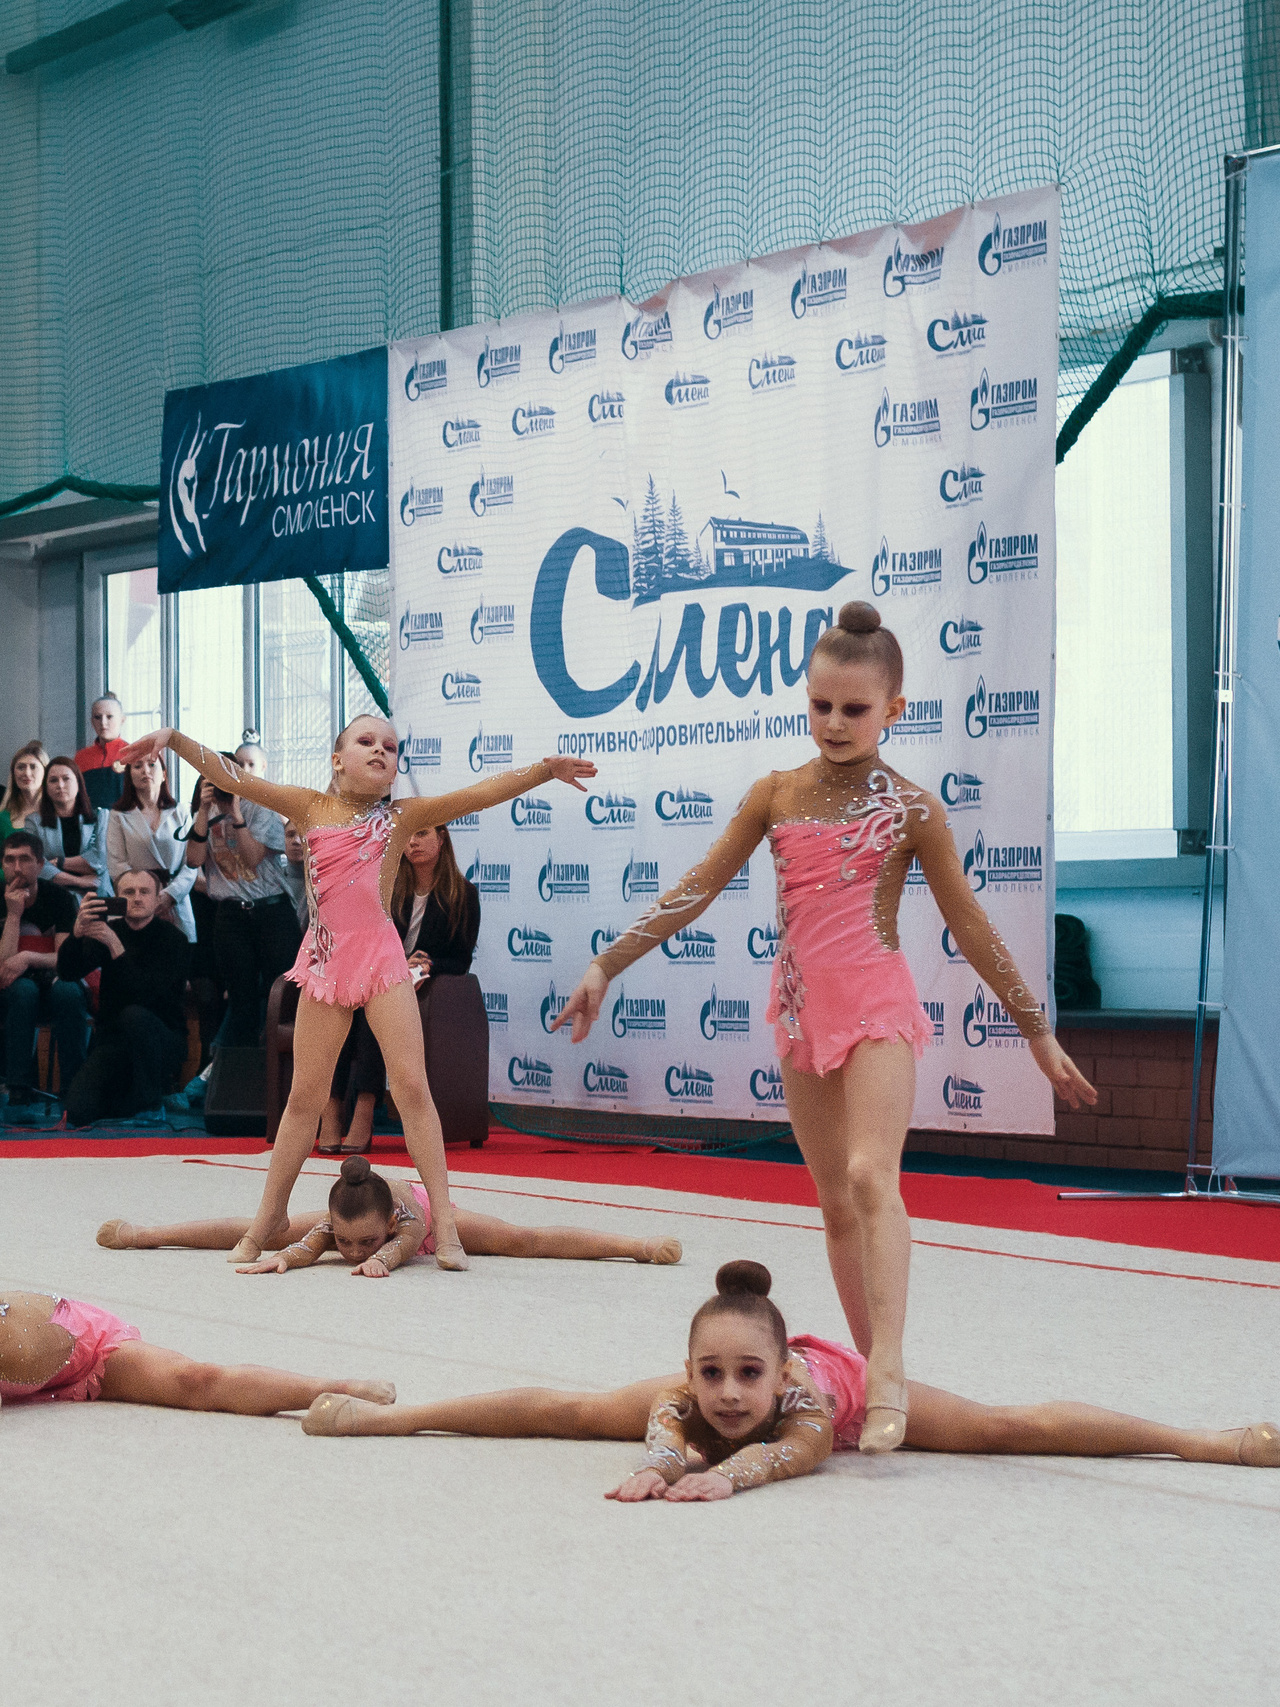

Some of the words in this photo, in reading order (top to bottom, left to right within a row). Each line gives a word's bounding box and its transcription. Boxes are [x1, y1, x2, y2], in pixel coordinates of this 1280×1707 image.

[1003, 220, 1047, 249] ГАЗПРОМ
[565, 329, 596, 351] ГАЗПРОМ
[835, 338, 886, 370] Смена
[749, 358, 795, 389] Смена
[665, 379, 709, 406] Смена
[991, 378, 1037, 405] ГАЗПРОМ
[512, 407, 555, 436] Смена
[893, 398, 939, 423] ГАЗПРОМ
[990, 414, 1037, 430] СМОЛЕНСК
[202, 418, 376, 527] Гармония
[415, 486, 444, 506] ГАЗПРОМ
[486, 475, 514, 496] ГАЗПРОМ
[272, 489, 376, 538] СМОЛЕНСК
[990, 533, 1038, 558] ГАЗПРОМ
[438, 547, 483, 573] Смена
[892, 548, 942, 571] ГАЗПРОМ
[989, 571, 1038, 584] СМОЛЕНСК
[410, 612, 443, 630] ГАЗПРОМ
[484, 605, 515, 623] ГАЗПРОМ
[442, 673, 481, 700] Смена
[901, 699, 942, 721] АЗПРОМ
[989, 690, 1039, 713] ГАЗПРОМ
[765, 713, 812, 738] комп
[989, 727, 1040, 738] СМОЛЕНСК
[412, 737, 441, 754] ГАЗПРОМ
[483, 734, 513, 752] ГАЗПРОМ
[891, 735, 943, 746] СМОЛЕНСК
[511, 798, 552, 826] Смена
[585, 795, 636, 825] Смена
[655, 791, 713, 821] Смена
[446, 811, 480, 826] мена
[987, 846, 1042, 868] ГАЗПРОМ
[480, 864, 511, 881] ГАЗПРОМ
[553, 864, 590, 881] ГАЗПРОМ
[987, 883, 1043, 893] СМОЛЕНСК
[508, 927, 552, 957] Смена
[661, 931, 716, 959] Смена
[483, 992, 508, 1011] ЗПРОМ
[626, 999, 666, 1017] ГАЗПРОМ
[717, 1000, 750, 1019] ГАЗПРОМ
[987, 1038, 1026, 1049] СМОЛЕ
[508, 1057, 552, 1086] Смена
[584, 1062, 628, 1093] Смена
[665, 1066, 714, 1097] Смена
[943, 1075, 983, 1110] Смена
